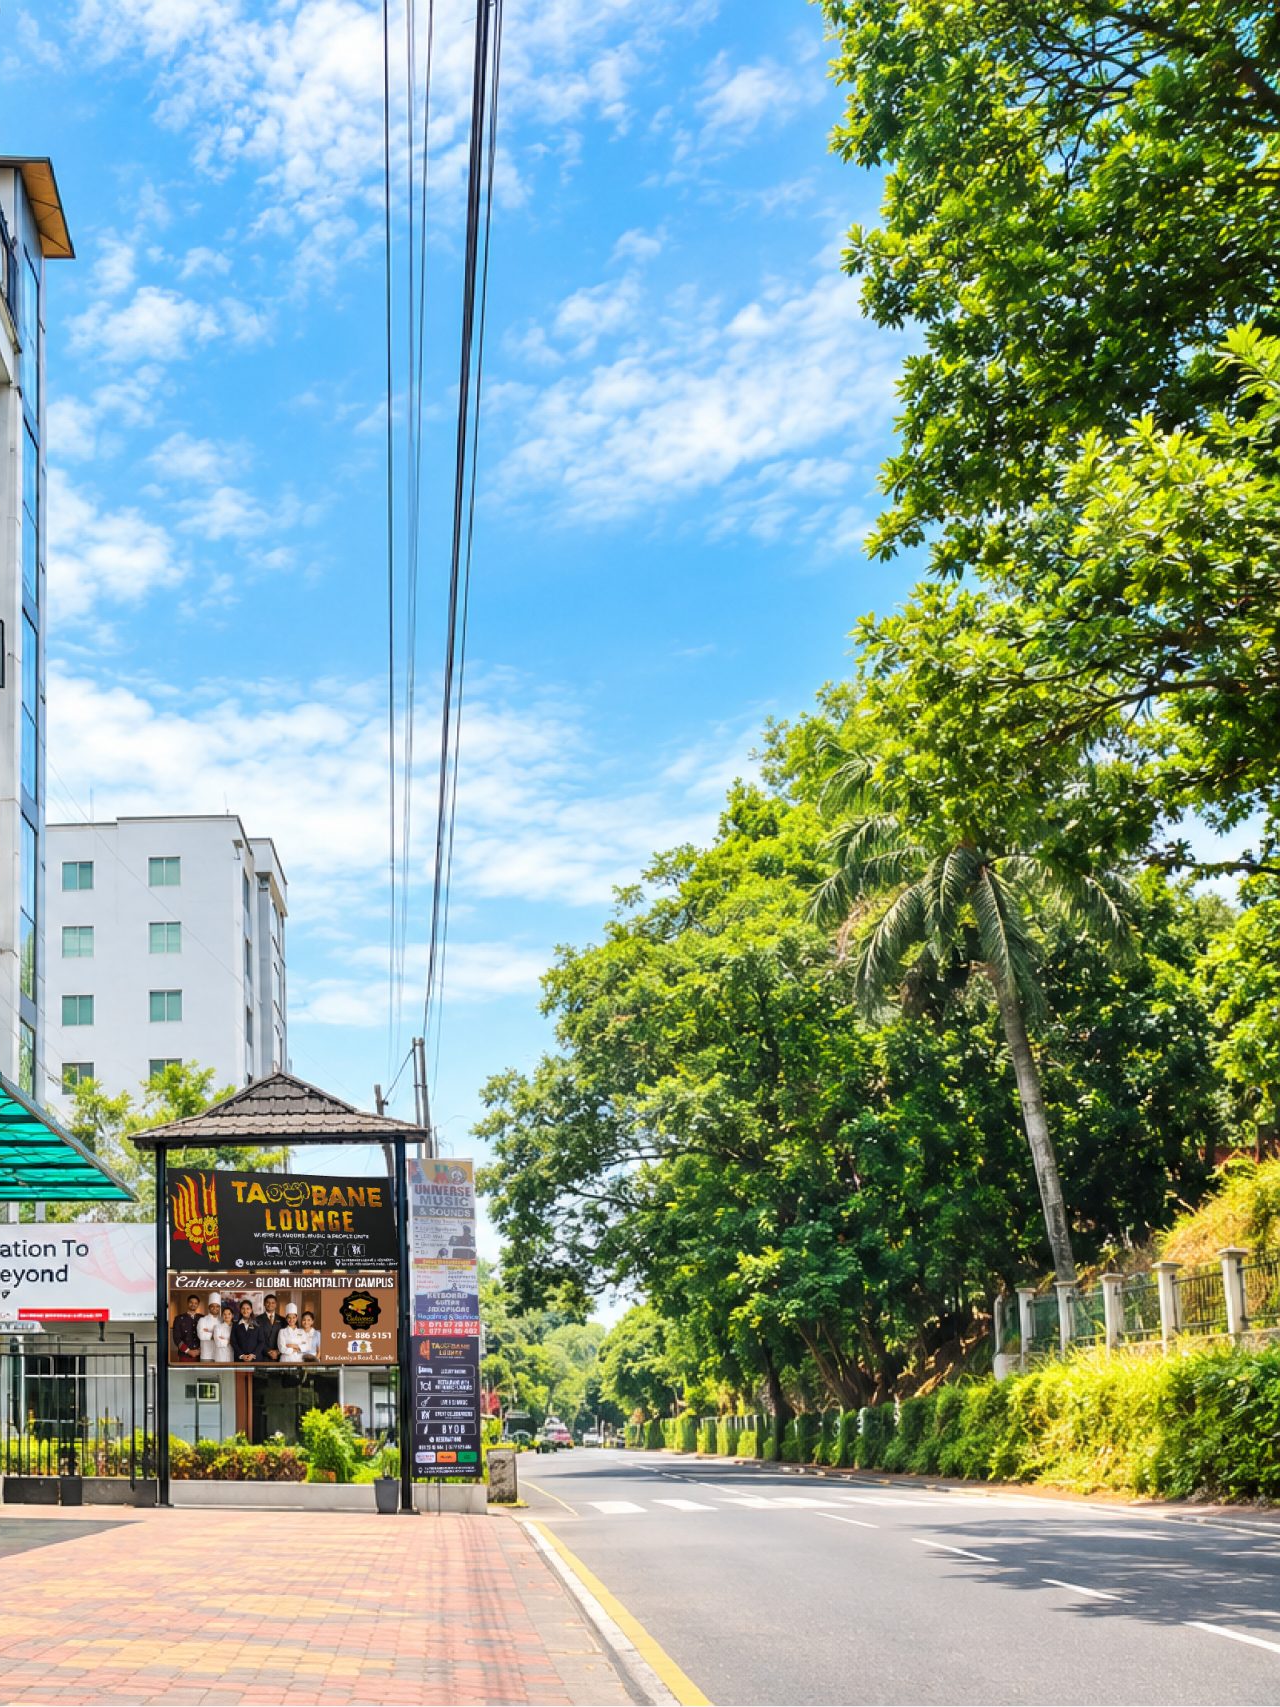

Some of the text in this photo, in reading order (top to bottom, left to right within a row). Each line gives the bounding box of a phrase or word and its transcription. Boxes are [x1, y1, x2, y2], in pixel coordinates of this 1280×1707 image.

[414, 1184, 472, 1197] UNIVERSE
[420, 1195, 469, 1207] MUSIC
[429, 1207, 471, 1217] SOUNDS
[265, 1208, 354, 1232] LOUNGE
[62, 1239, 89, 1257] To
[256, 1277, 292, 1288] GLOBAL
[294, 1277, 352, 1288] HOSPITALITY
[354, 1277, 394, 1288] CAMPUS
